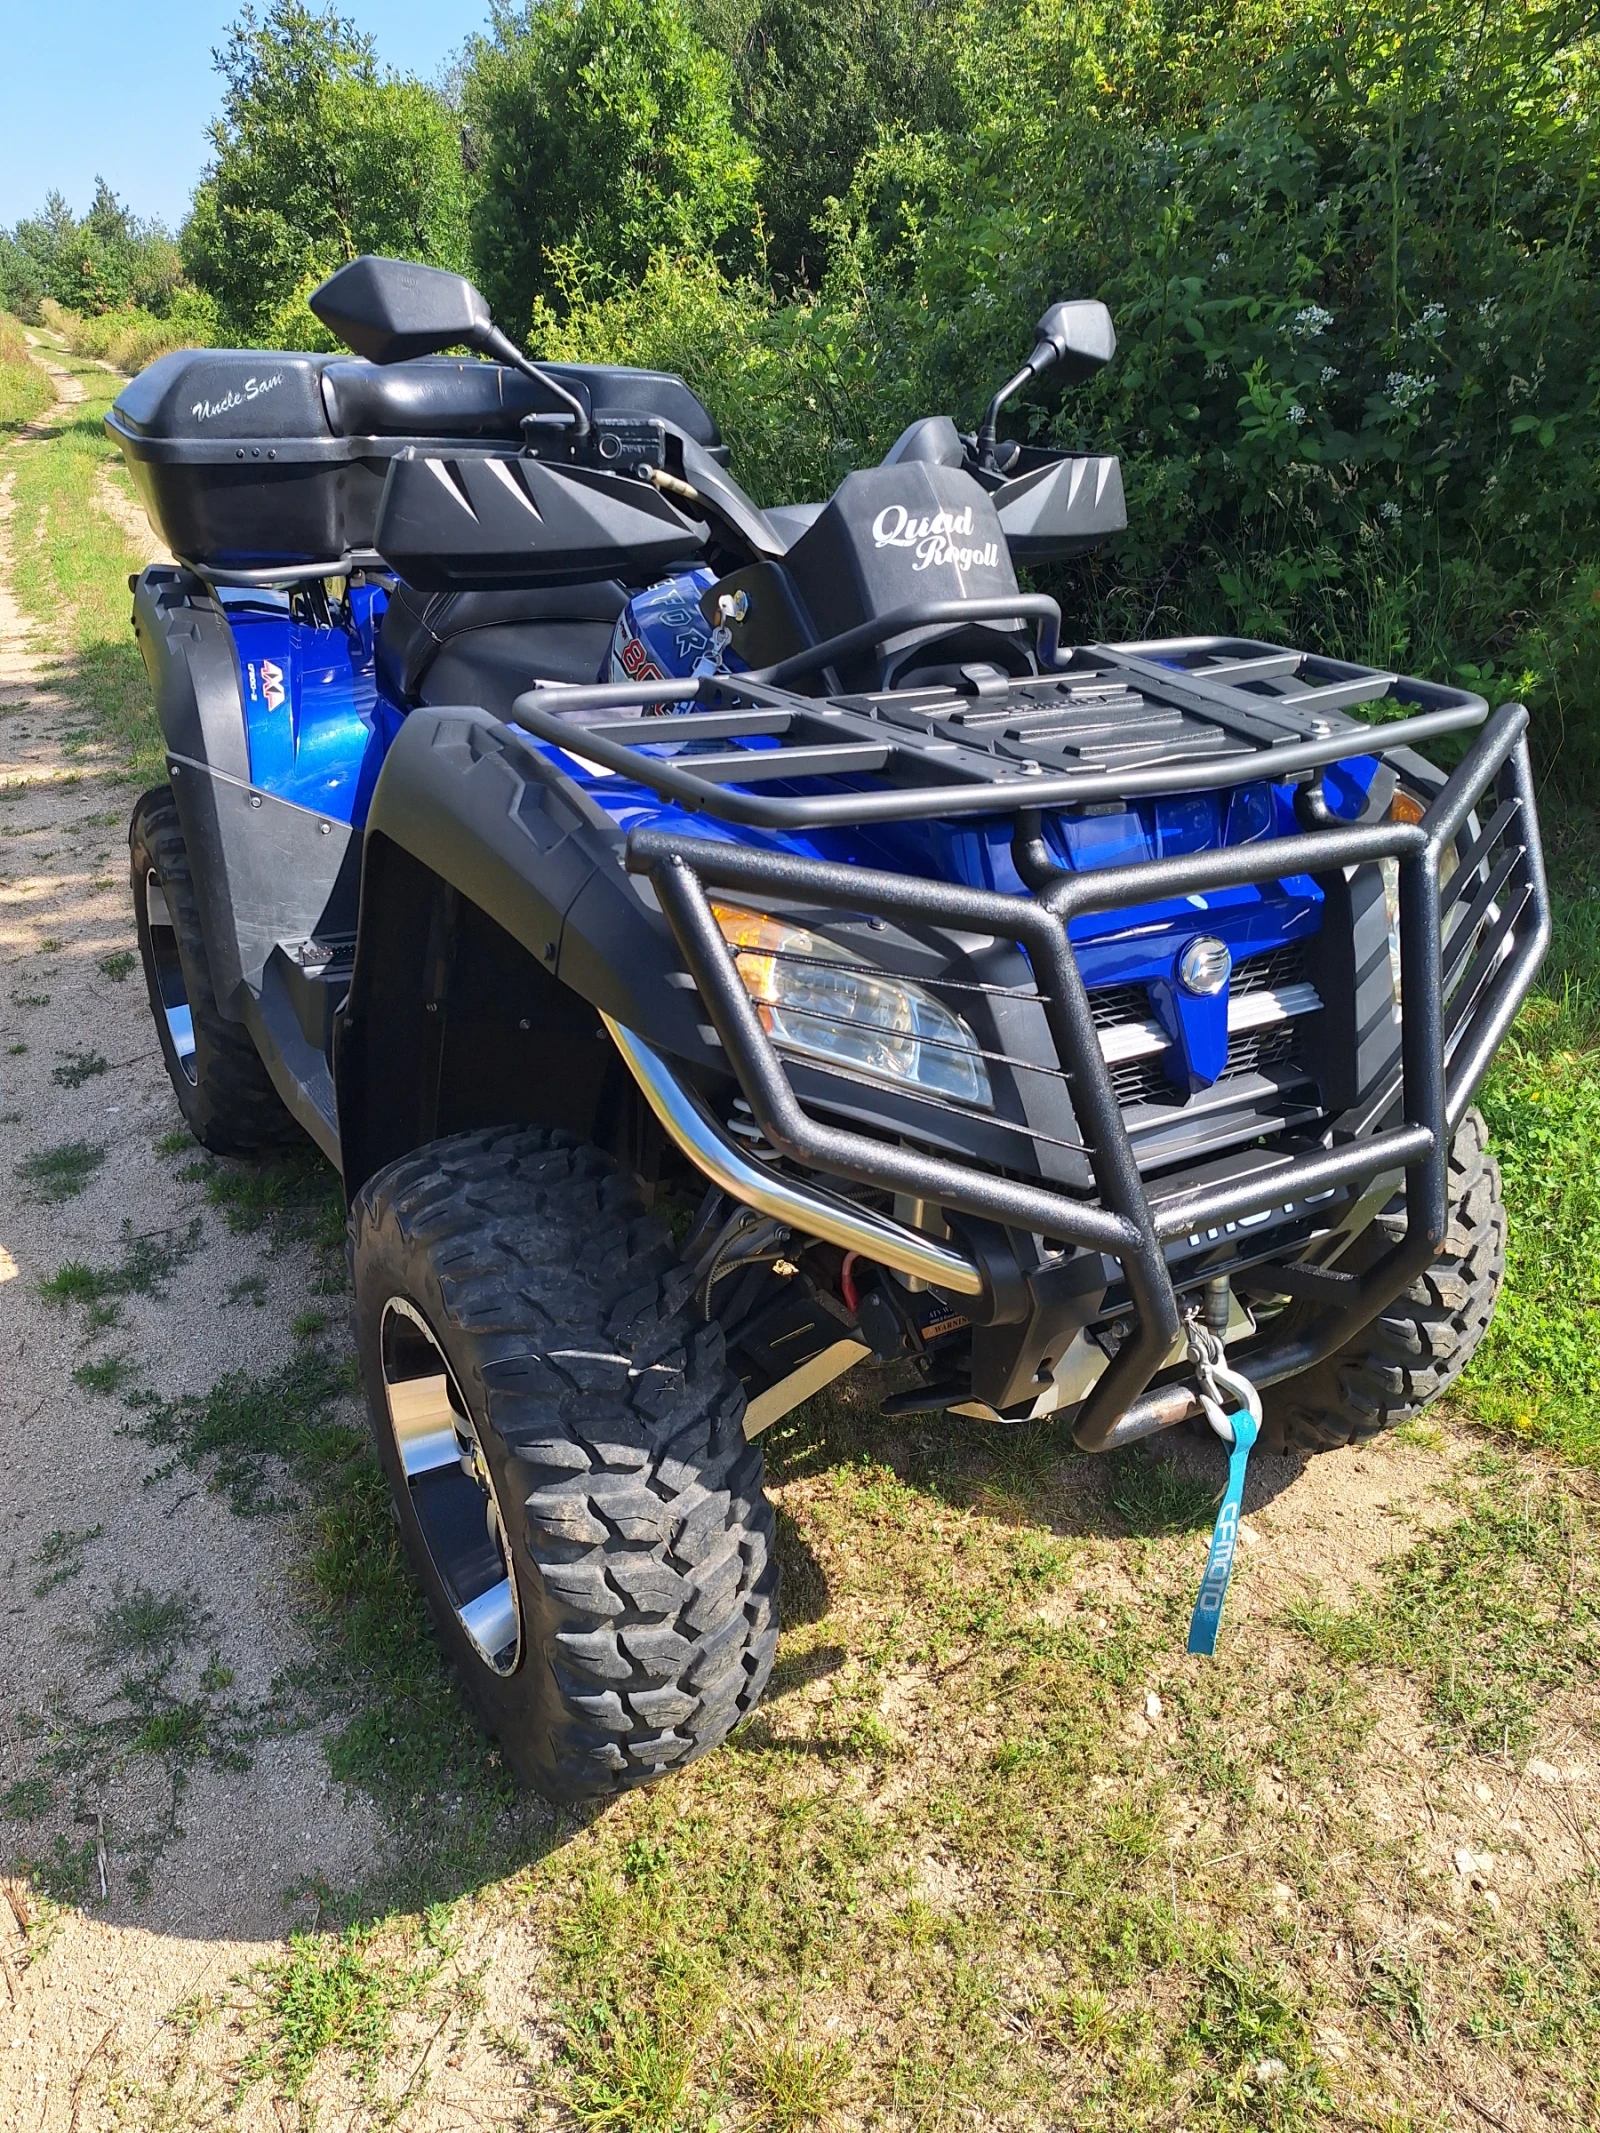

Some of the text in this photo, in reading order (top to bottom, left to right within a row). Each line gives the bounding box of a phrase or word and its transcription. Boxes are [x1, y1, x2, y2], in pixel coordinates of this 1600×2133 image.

[190, 369, 284, 422] Uncle Sam
[872, 505, 974, 548] Quad
[934, 1317, 968, 1333] WARNIN
[1200, 1502, 1239, 1612] CFMOTO
